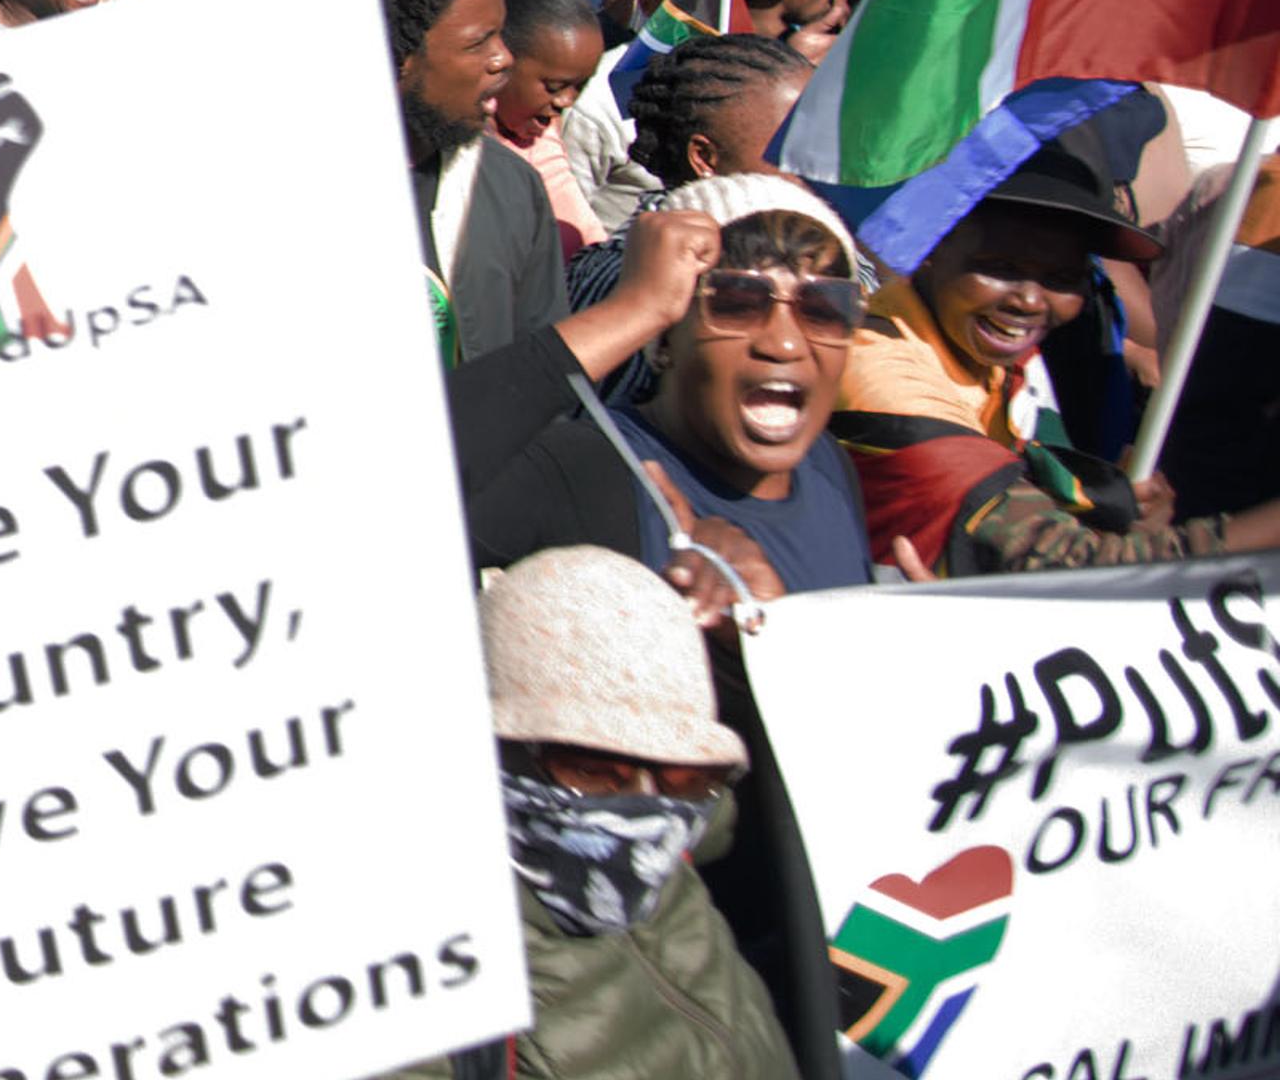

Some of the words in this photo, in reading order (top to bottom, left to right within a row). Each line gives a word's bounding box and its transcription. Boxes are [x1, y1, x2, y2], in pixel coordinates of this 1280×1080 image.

[42, 417, 308, 539] Your
[102, 700, 356, 817] Your
[1027, 774, 1187, 874] OUR
